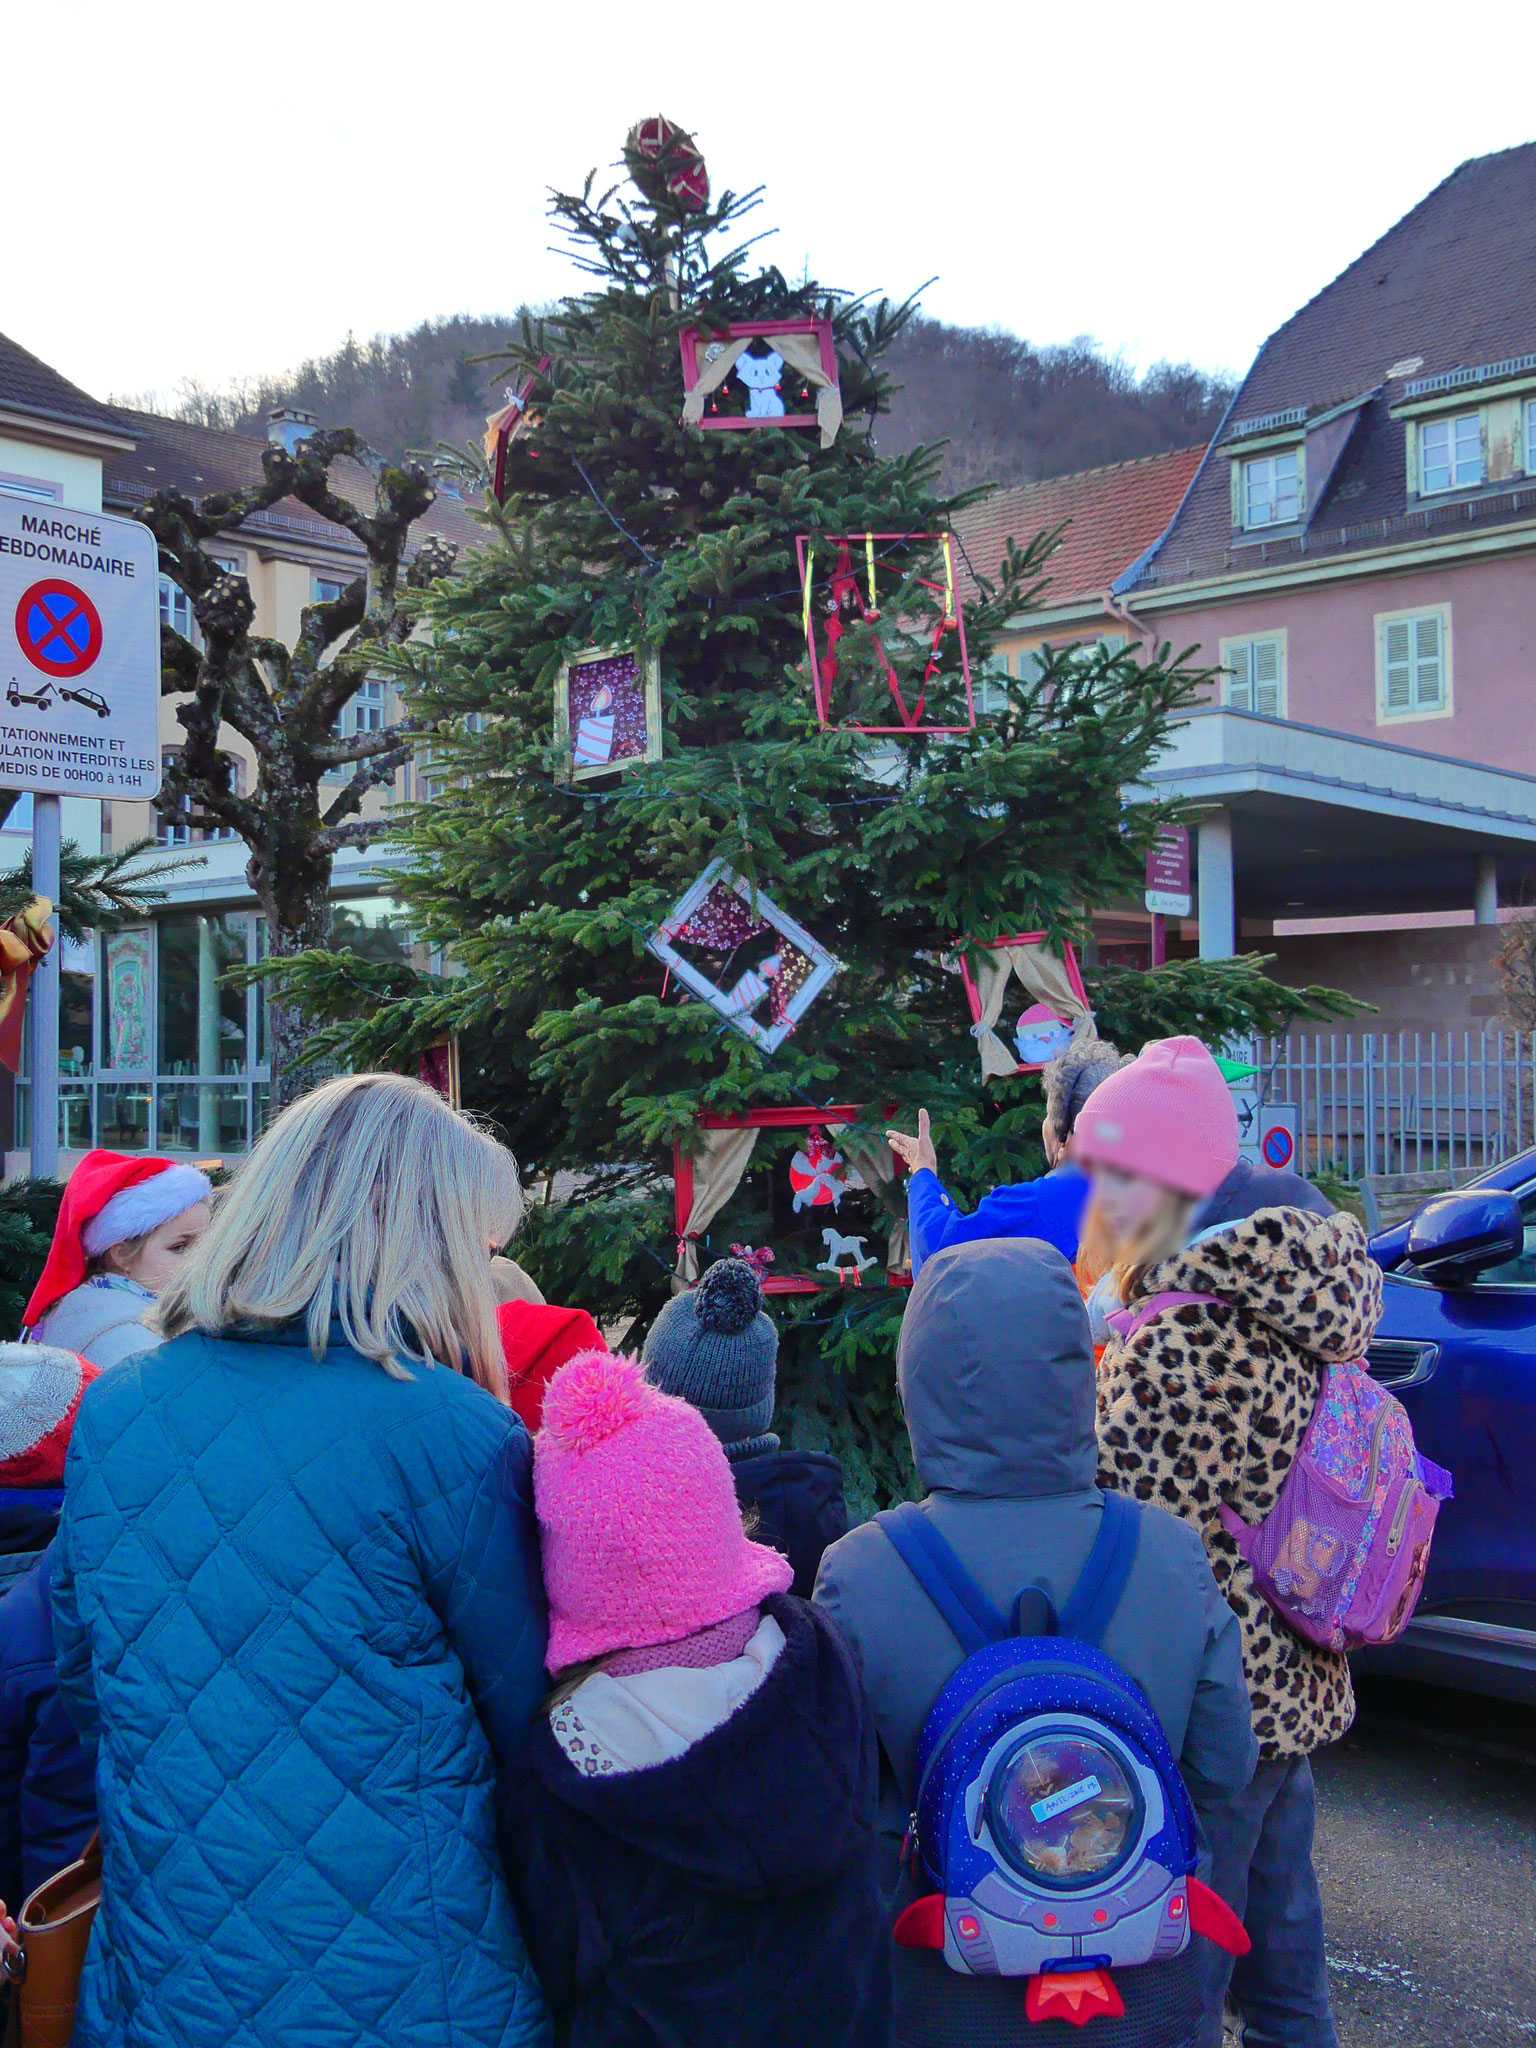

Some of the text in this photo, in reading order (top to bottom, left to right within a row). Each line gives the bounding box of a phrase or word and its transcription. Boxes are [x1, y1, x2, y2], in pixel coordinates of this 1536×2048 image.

[21, 514, 102, 547] MARCHÉ
[0, 726, 126, 751] TATIONNEMENT ET
[57, 750, 128, 769] INTERDITS
[131, 758, 155, 771] LES
[42, 766, 61, 778] DE
[64, 768, 104, 783] 00H00
[107, 773, 115, 784] à
[118, 774, 142, 786] 14H
